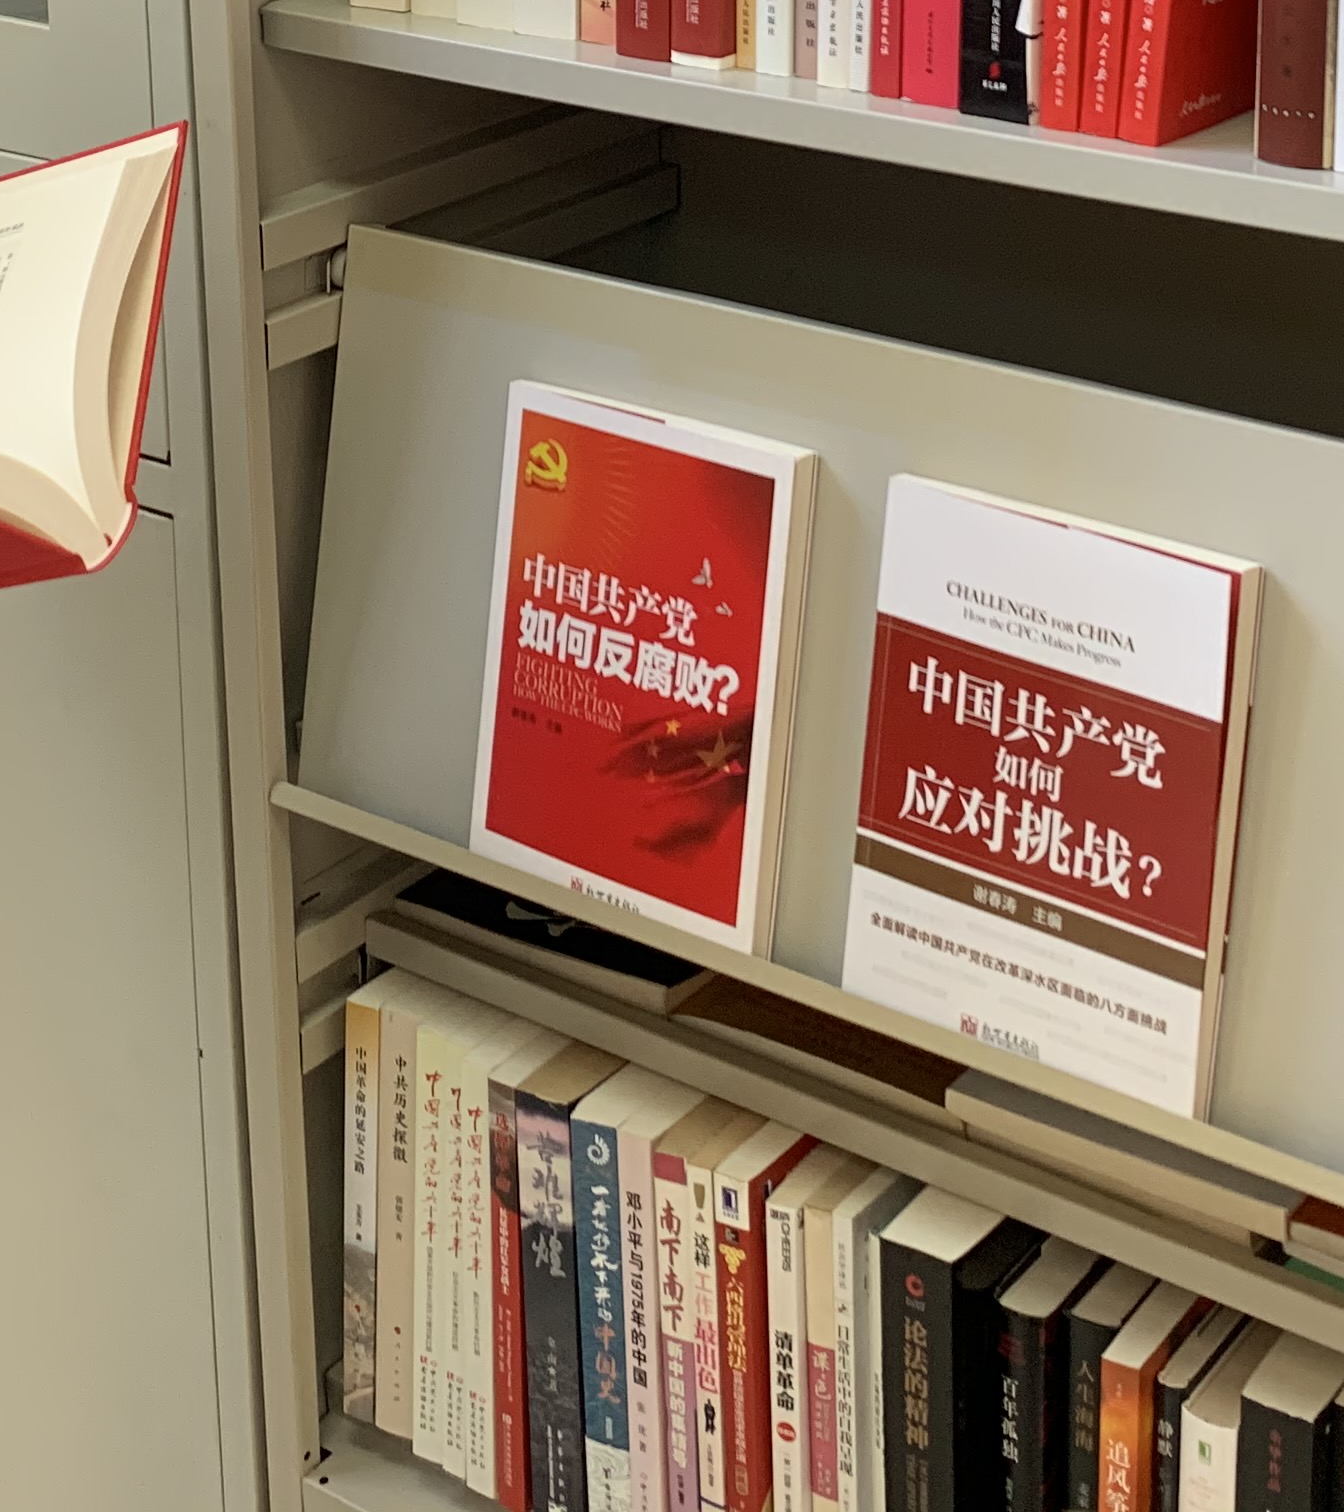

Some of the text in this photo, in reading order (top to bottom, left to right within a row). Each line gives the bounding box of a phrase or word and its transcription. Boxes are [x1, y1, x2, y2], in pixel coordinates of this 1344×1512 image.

[523, 553, 697, 648] 中国共产党
[946, 580, 1049, 627] CHALLENGES
[1077, 620, 1136, 655] CHINA
[962, 606, 1122, 668] How the CPC Makes Progress
[514, 670, 623, 721] CORRUPTION
[517, 600, 740, 716] 如何反腐败？
[908, 656, 1166, 789] 中国共产党
[993, 745, 1063, 802] 如何
[898, 764, 1163, 900] 应对挑战？
[973, 883, 1063, 931] 谢春涛 主编
[870, 912, 1167, 1035] 全面解读中国共产党在改革深水区面临的八方面挑战
[355, 1047, 367, 1175] 中国革命的延安之路
[393, 1054, 408, 1164] 中共历史探微
[625, 1190, 647, 1389] 邓小平与1975年的中国
[660, 1198, 685, 1334] 南下南下
[781, 1223, 792, 1272] CHEERS
[693, 1231, 719, 1395] 这样工作最出色
[774, 1330, 795, 1412] 清单革命
[837, 1325, 853, 1477] 日常生活中的自我呈现
[903, 1315, 928, 1451] 论法的精神
[1001, 1374, 1019, 1464] 百年孤独
